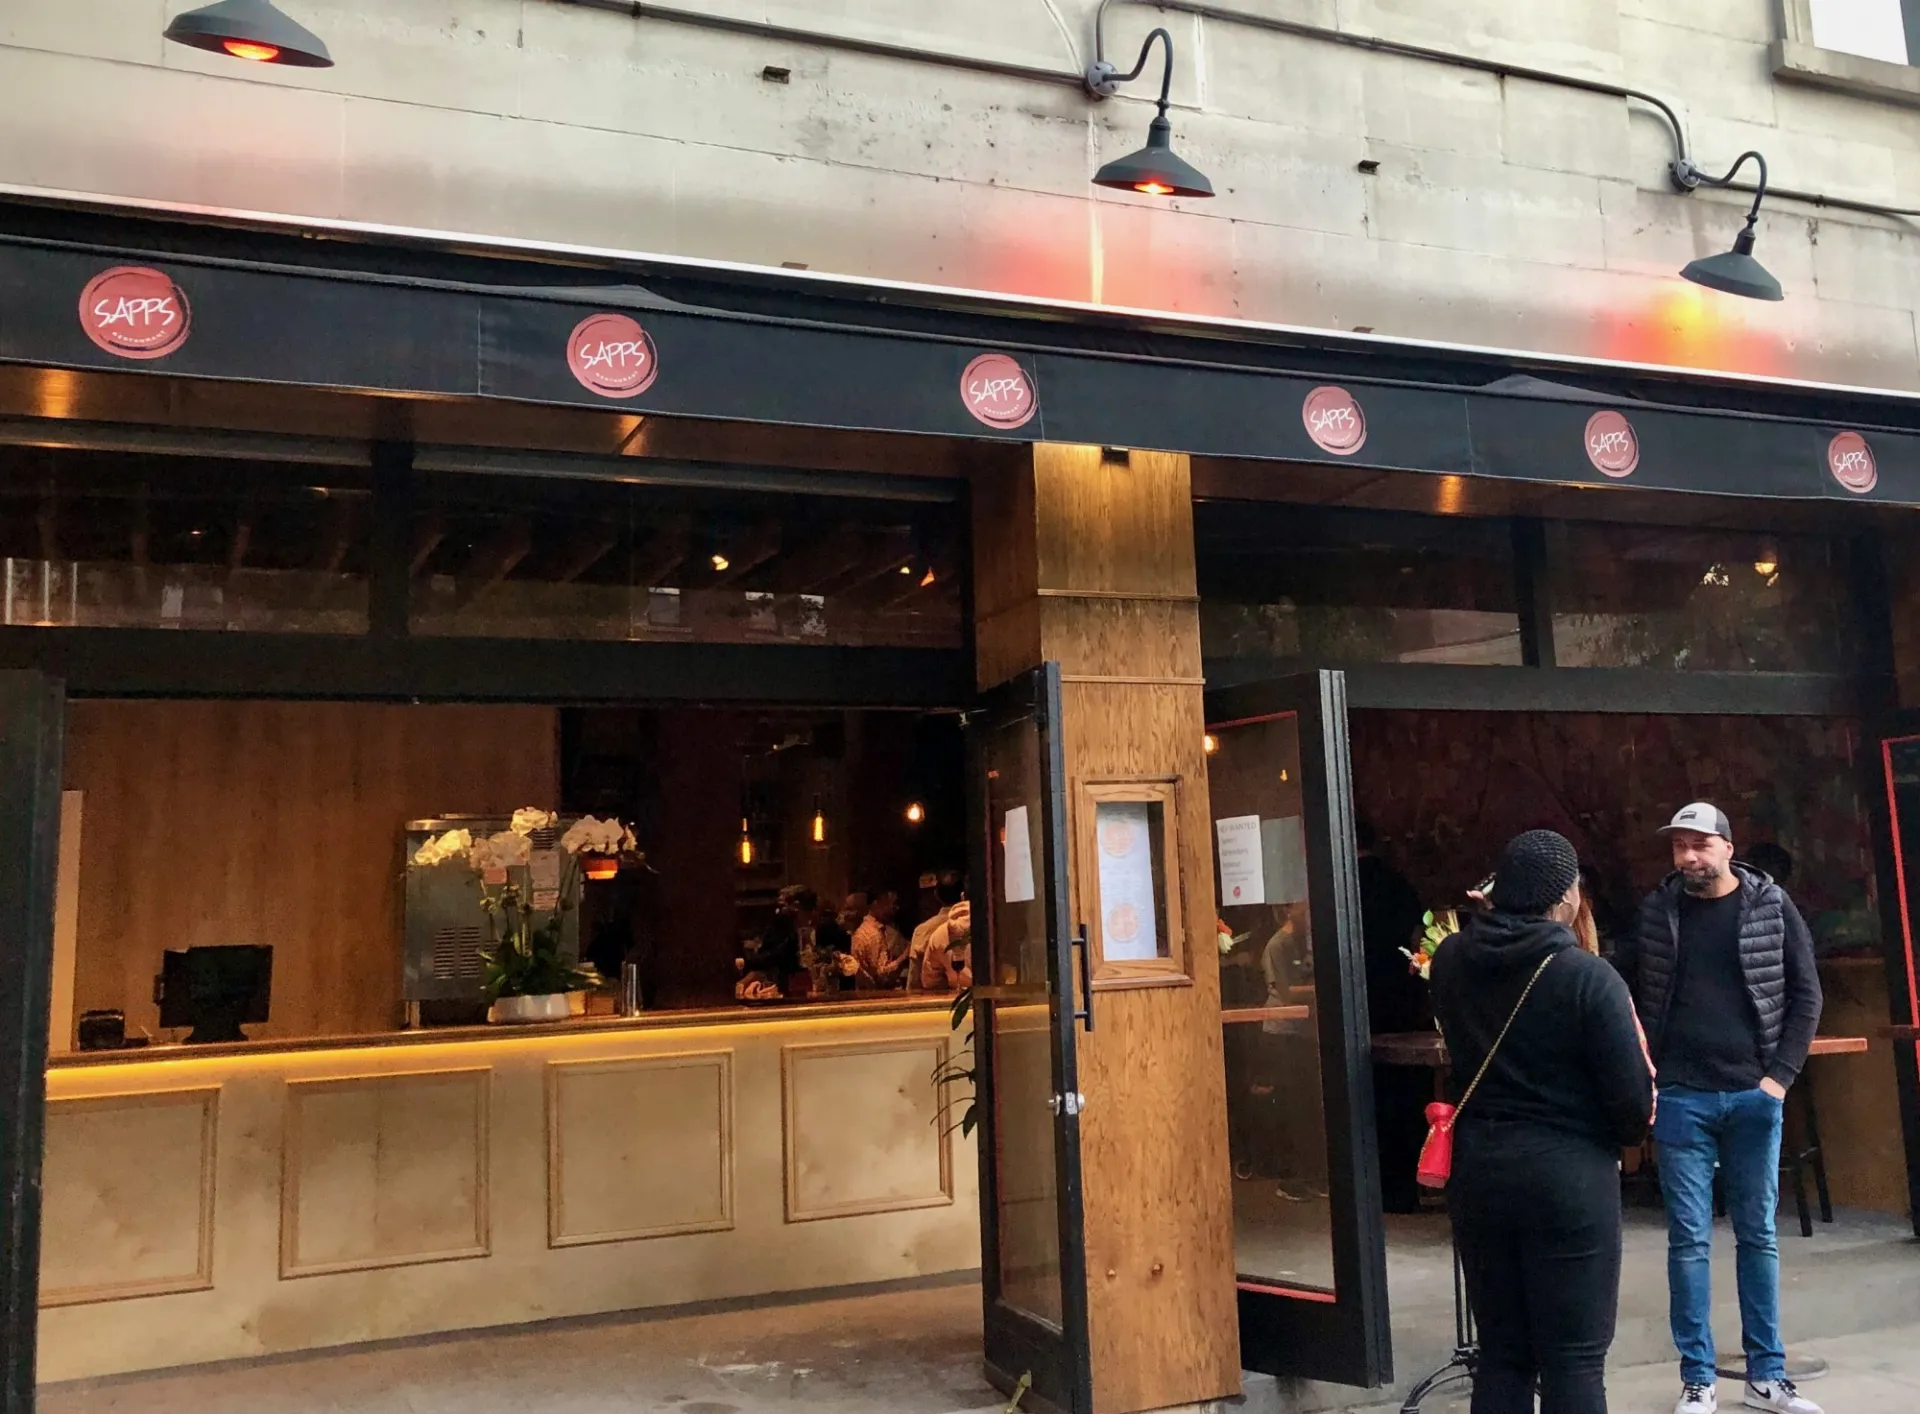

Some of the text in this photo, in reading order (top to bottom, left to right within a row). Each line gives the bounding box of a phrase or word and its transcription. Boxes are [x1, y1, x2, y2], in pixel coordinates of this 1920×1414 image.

[94, 296, 175, 328] SAPPS
[580, 340, 646, 370] SAPPS
[969, 376, 1024, 404] SAPPS
[1310, 407, 1355, 432] SAPPS
[1590, 430, 1629, 456] SAPPS
[1833, 450, 1868, 473] SAPPS
